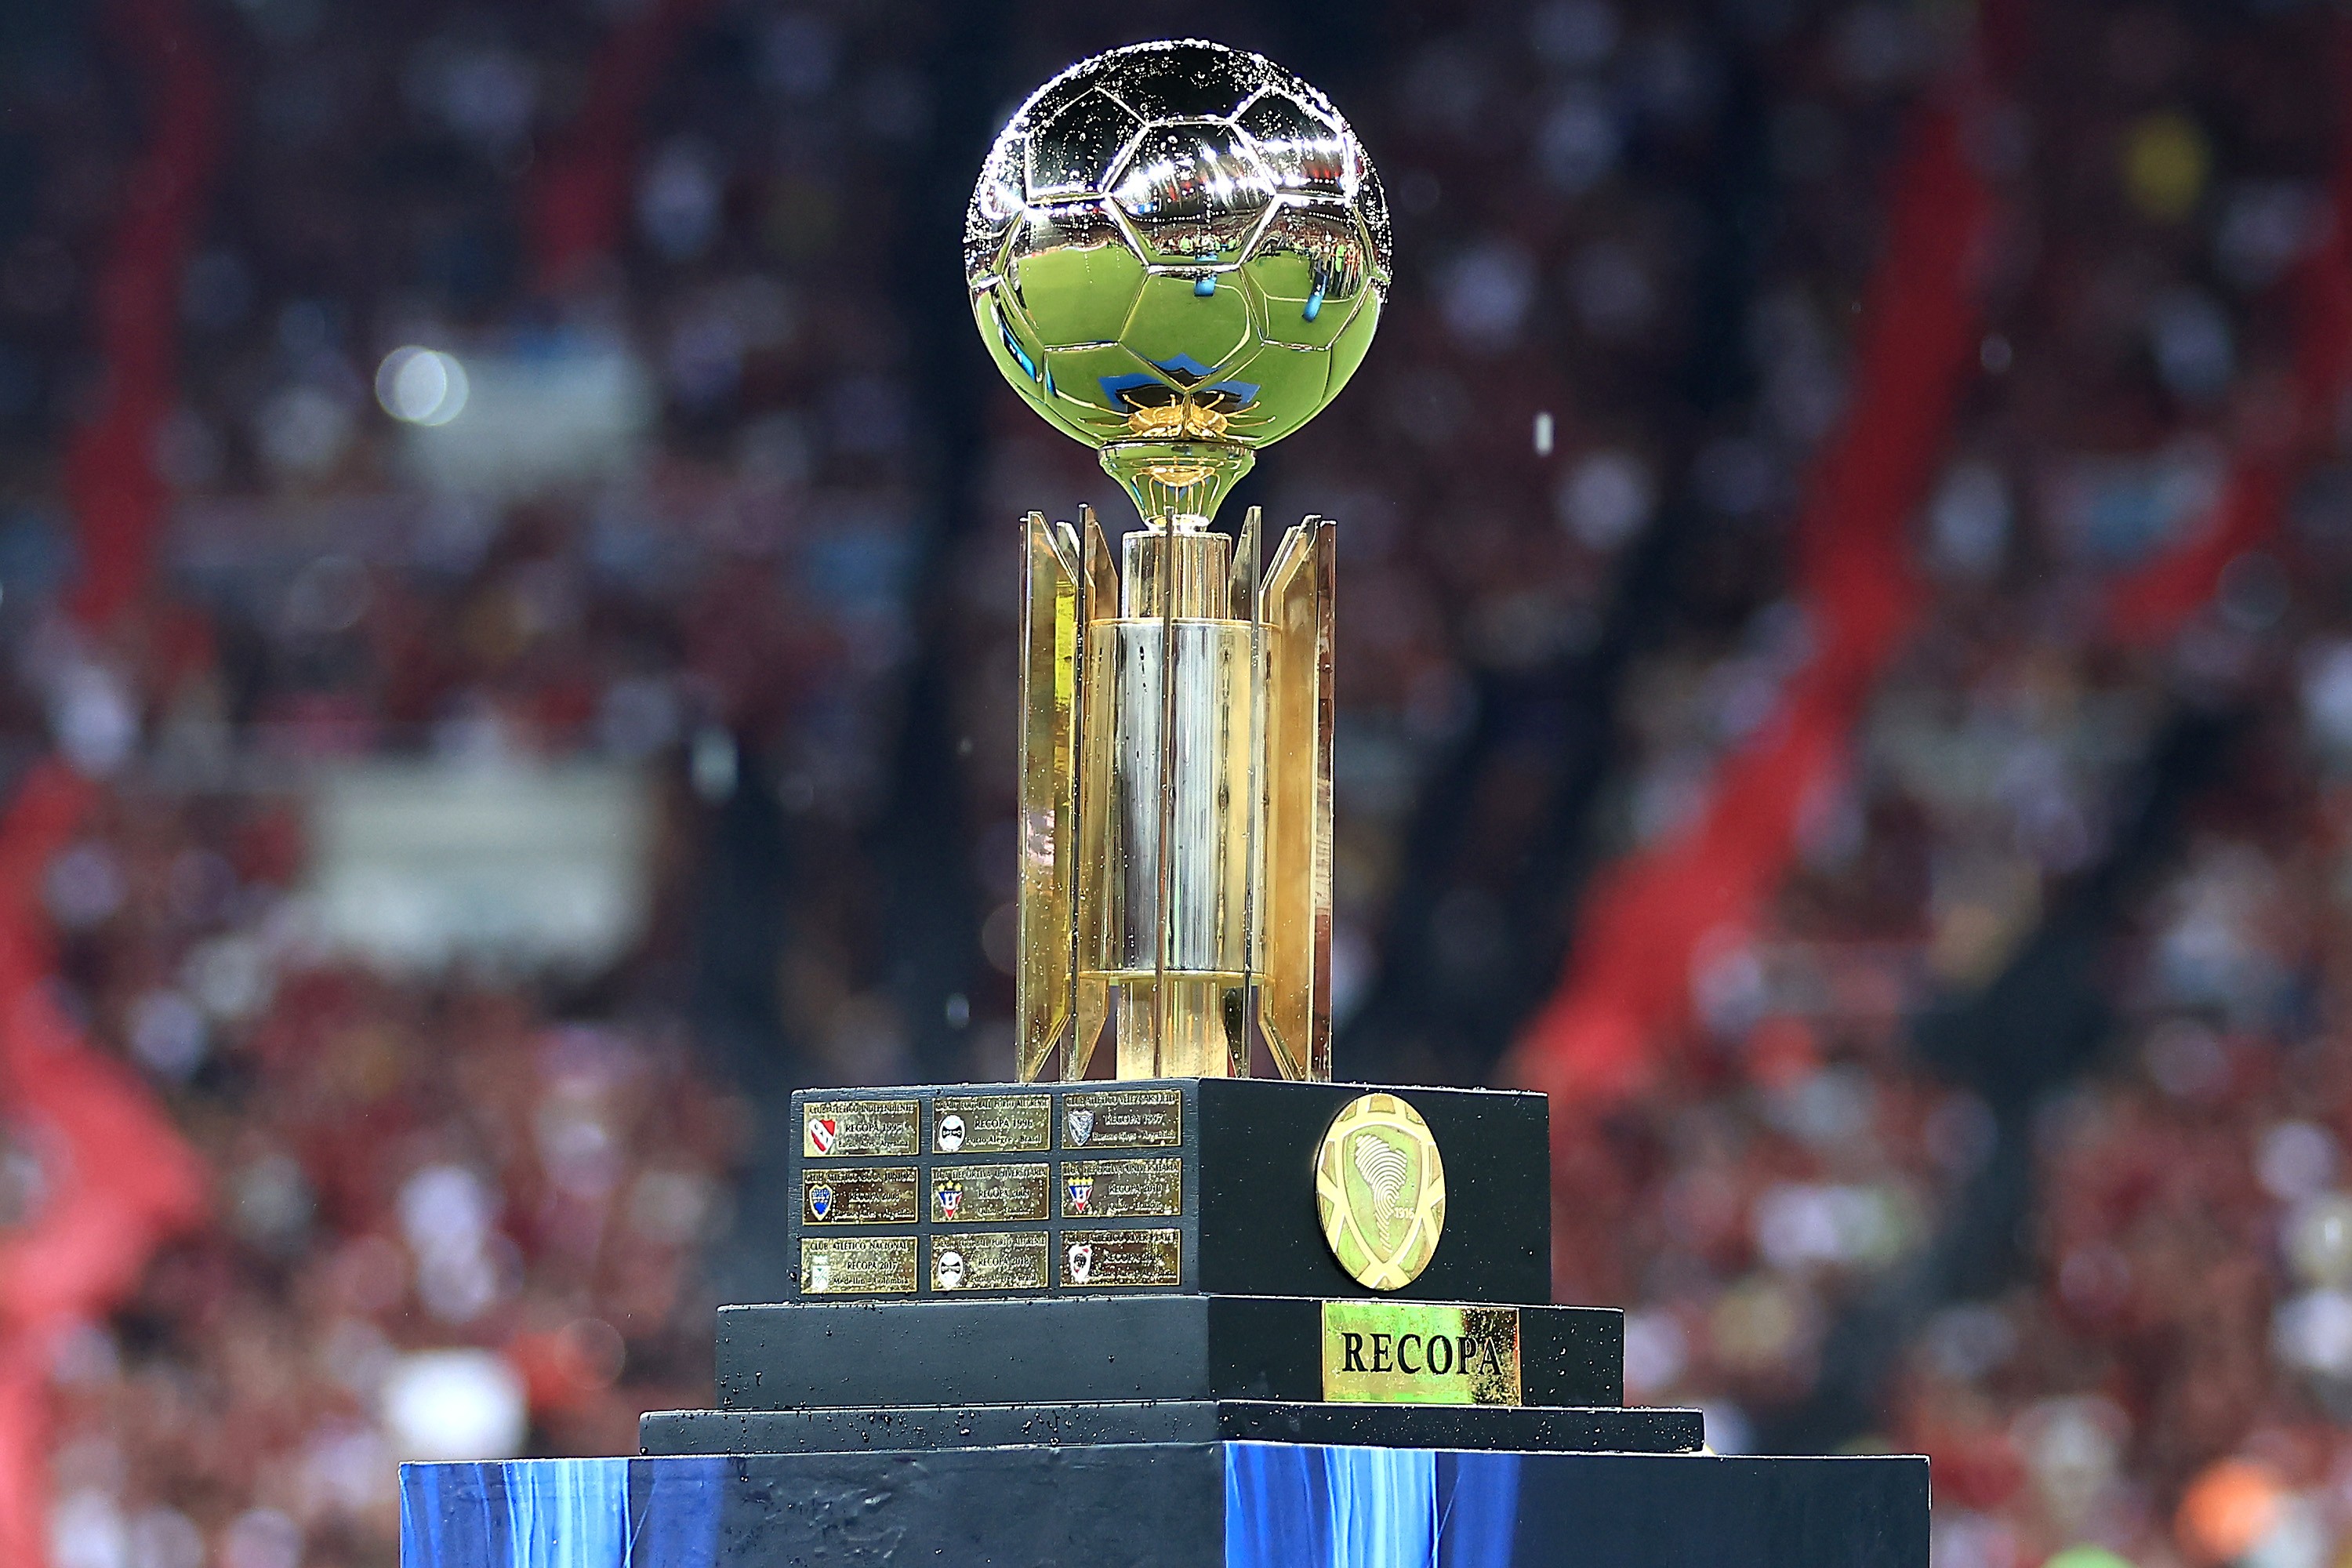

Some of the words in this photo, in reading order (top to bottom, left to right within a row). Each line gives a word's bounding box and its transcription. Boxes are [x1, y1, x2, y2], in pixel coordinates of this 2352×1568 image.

[974, 1119, 1011, 1130] RECOPA
[1012, 1118, 1033, 1129] 1996
[1105, 1114, 1142, 1125] RECOPA
[1143, 1113, 1164, 1124] 1997
[846, 1123, 879, 1133] RECOPA
[966, 1136, 987, 1145] Porto
[989, 1135, 1013, 1146] Alegre
[1020, 1134, 1042, 1144] Brasil
[977, 1190, 1009, 1200] RECOPA
[1108, 1184, 1142, 1196] RECOPA
[1394, 1207, 1415, 1220] 1916
[810, 1241, 829, 1251] CLUB
[833, 1240, 866, 1251] ATLETICO
[870, 1240, 909, 1250] NACIONAL
[978, 1257, 1010, 1268] RECOPA
[1102, 1251, 1142, 1264] RECOPA
[847, 1261, 878, 1271] RECOPA
[880, 1261, 899, 1271] 2017
[874, 1276, 909, 1286] Colombia
[1341, 1331, 1504, 1376] RECOPA
